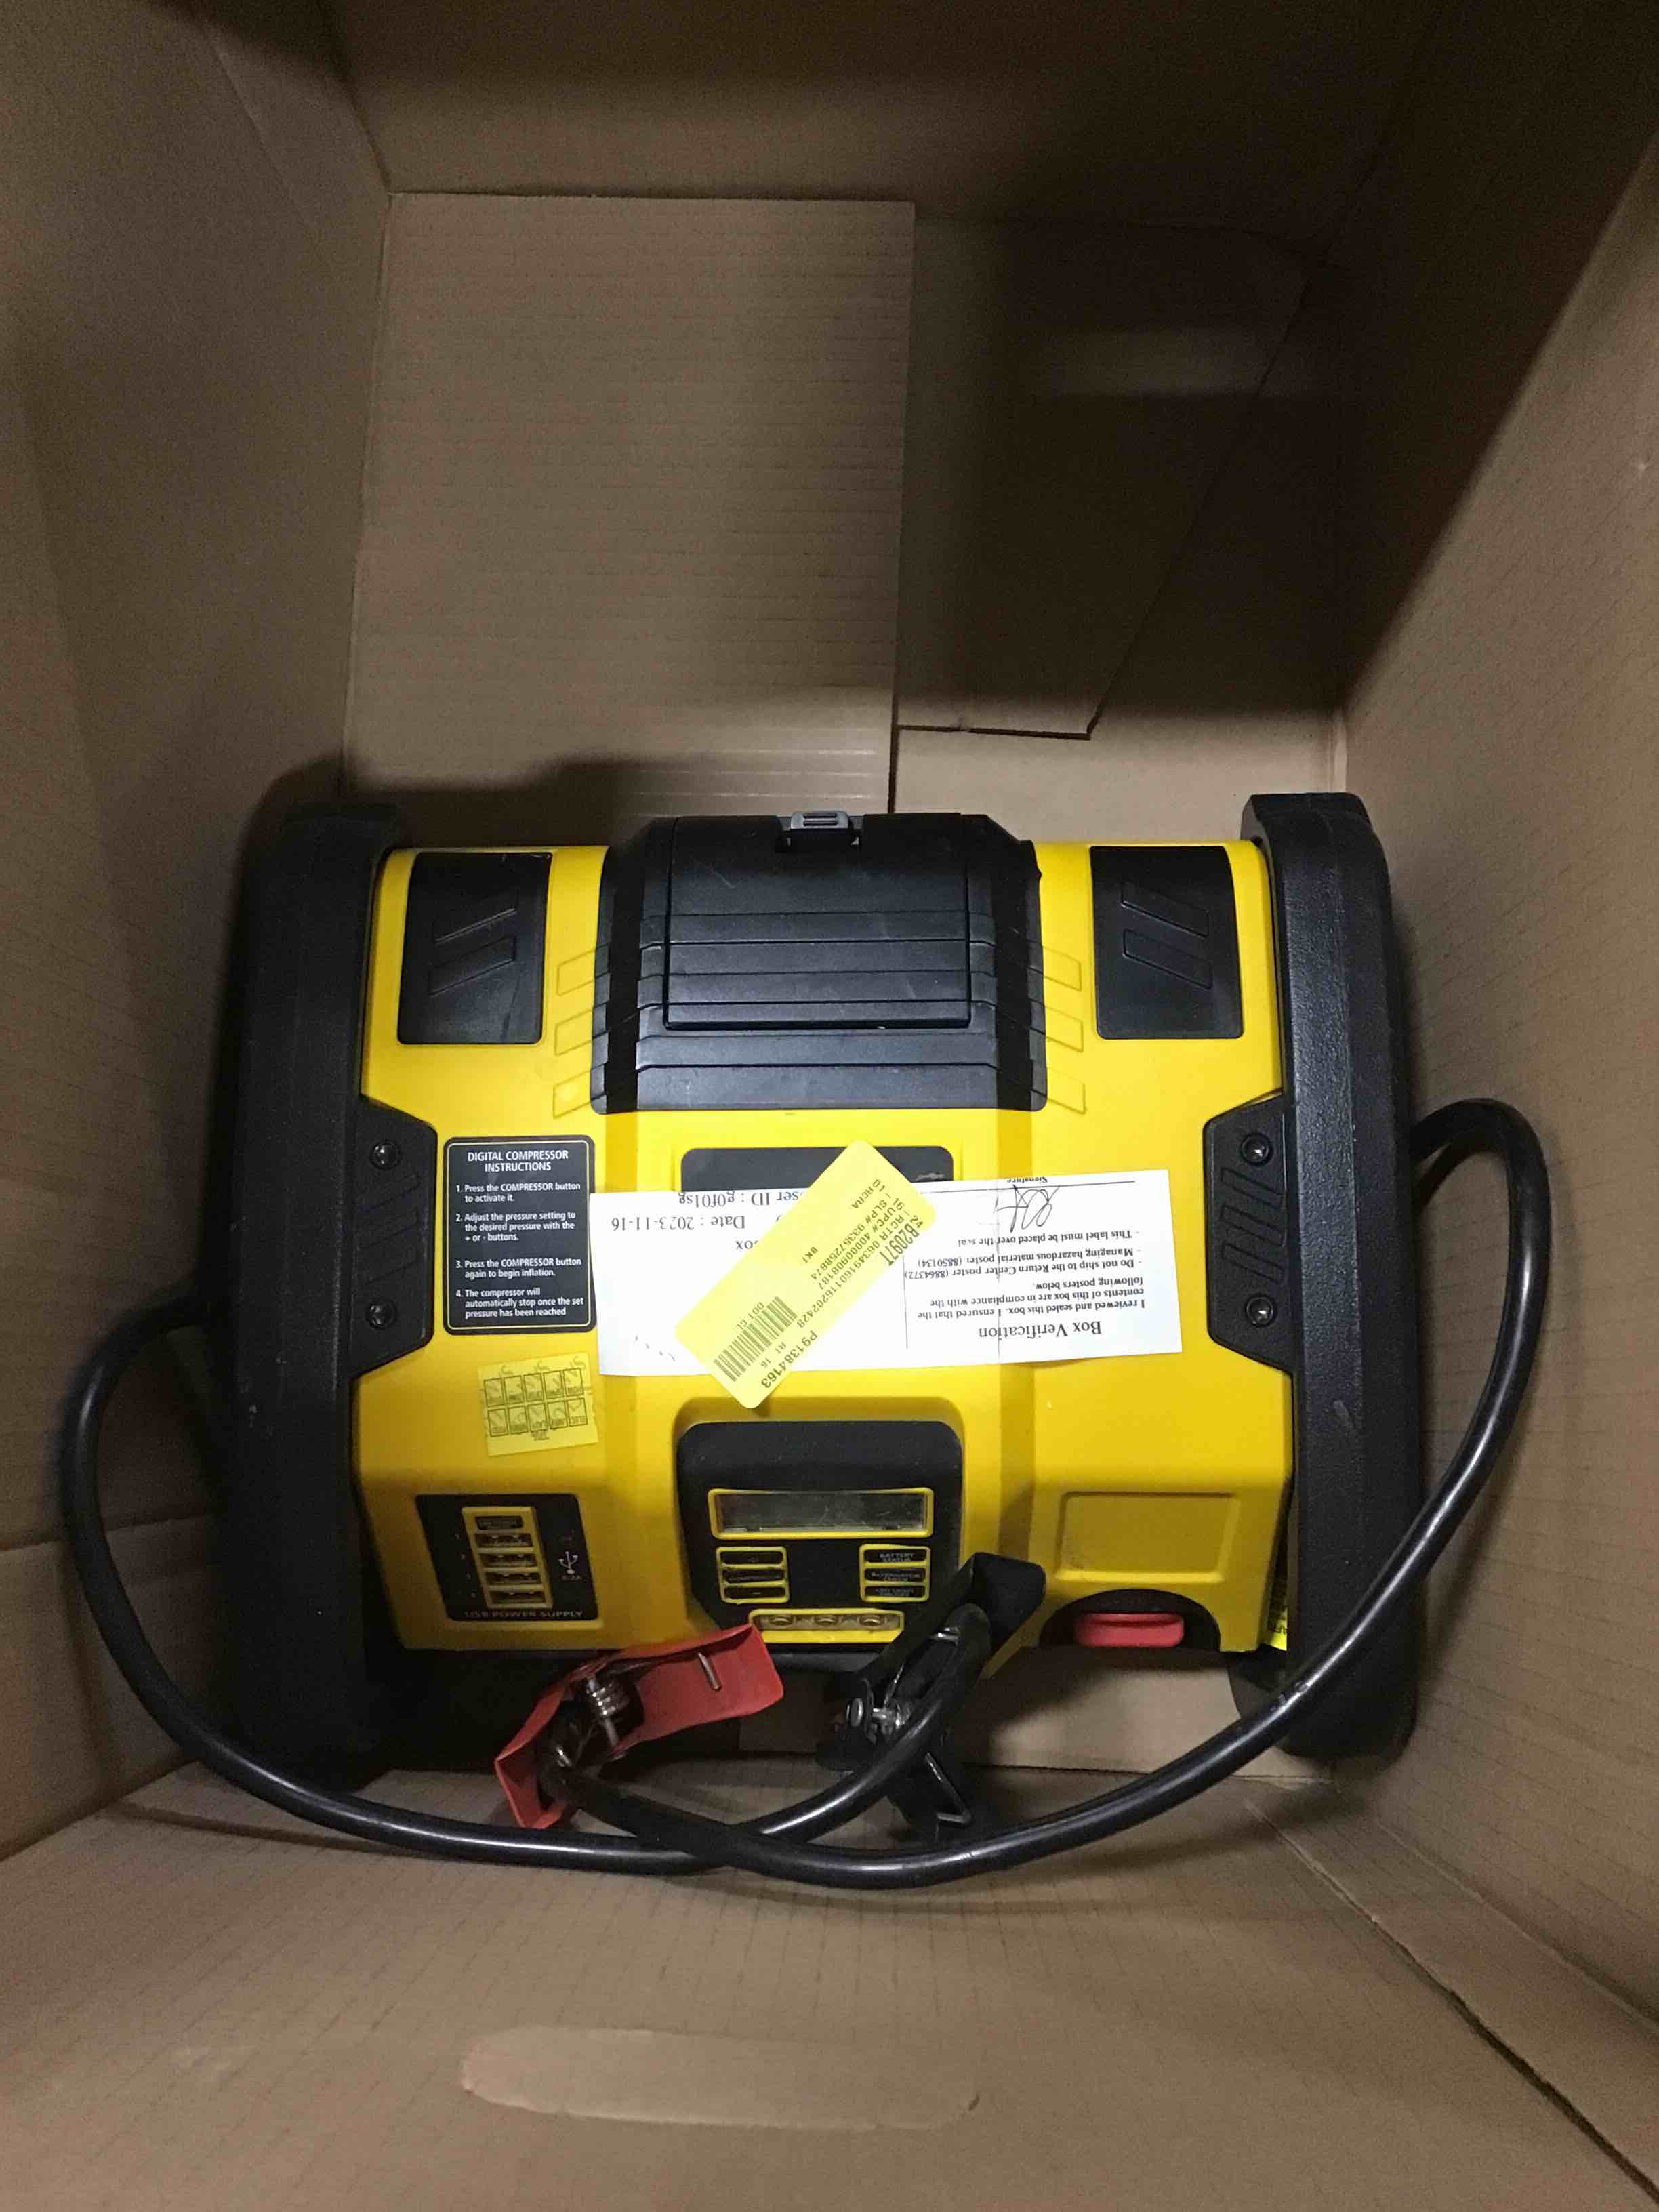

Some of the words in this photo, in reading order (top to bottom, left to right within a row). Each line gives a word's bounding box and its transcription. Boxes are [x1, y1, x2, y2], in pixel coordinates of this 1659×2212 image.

[468, 1152, 503, 1161] DIGITAL
[506, 1150, 569, 1160] COMPRESSOR
[485, 1162, 551, 1172] INSTRUCTIONS
[750, 1192, 770, 1206] ID
[777, 1191, 802, 1202] ser
[455, 1214, 463, 1222] 2.
[465, 1213, 489, 1223] Adjust
[506, 1213, 537, 1224] pressure
[539, 1212, 566, 1221] setting
[710, 1216, 745, 1229] Date
[509, 1223, 541, 1232] pressure
[878, 1214, 905, 1241] RCTR
[1018, 1234, 1046, 1244] placed
[1048, 1235, 1058, 1243] be
[1061, 1233, 1083, 1242] must
[1086, 1231, 1108, 1241] label
[1111, 1230, 1132, 1239] This
[735, 1240, 759, 1251] ox
[878, 1222, 920, 1267] B2097T
[1036, 1252, 1083, 1261] hazardous
[1085, 1248, 1133, 1258] Managing
[501, 1258, 554, 1267] COMPRESSOR
[966, 1254, 995, 1264] poster
[998, 1254, 1034, 1265] material
[1120, 1259, 1134, 1268] Do
[1019, 1264, 1049, 1273] Return
[1052, 1264, 1065, 1272] the
[1079, 1261, 1099, 1270] ship
[1102, 1261, 1118, 1269] not
[465, 1271, 486, 1280] again
[498, 1269, 520, 1279] begin
[522, 1269, 555, 1277] inflation.
[952, 1267, 981, 1277] poster
[985, 1266, 1016, 1275] Center
[1063, 1278, 1095, 1290] posters
[1099, 1277, 1143, 1288] following
[465, 1289, 479, 1297] The
[481, 1289, 524, 1298] compressor
[1072, 1292, 1089, 1300] this
[1092, 1290, 1101, 1299] of
[1103, 1288, 1144, 1298] contents
[465, 1298, 517, 1308] automatically
[930, 1300, 944, 1308] the
[947, 1299, 968, 1307] with
[970, 1294, 1025, 1305] compliance
[1141, 1300, 1145, 1308] I
[1046, 1304, 1073, 1313] sealed
[1075, 1303, 1092, 1312] and
[1094, 1299, 1138, 1311] reviewed
[466, 1310, 498, 1319] pressure
[499, 1307, 513, 1317] has
[515, 1307, 534, 1316] been
[536, 1307, 566, 1315] reached
[918, 1312, 932, 1320] the
[935, 1311, 953, 1319] that
[956, 1309, 995, 1319] ensured
[979, 1324, 1068, 1341] Verification
[1072, 1321, 1101, 1335] Box
[760, 1329, 818, 1389] P91384163
